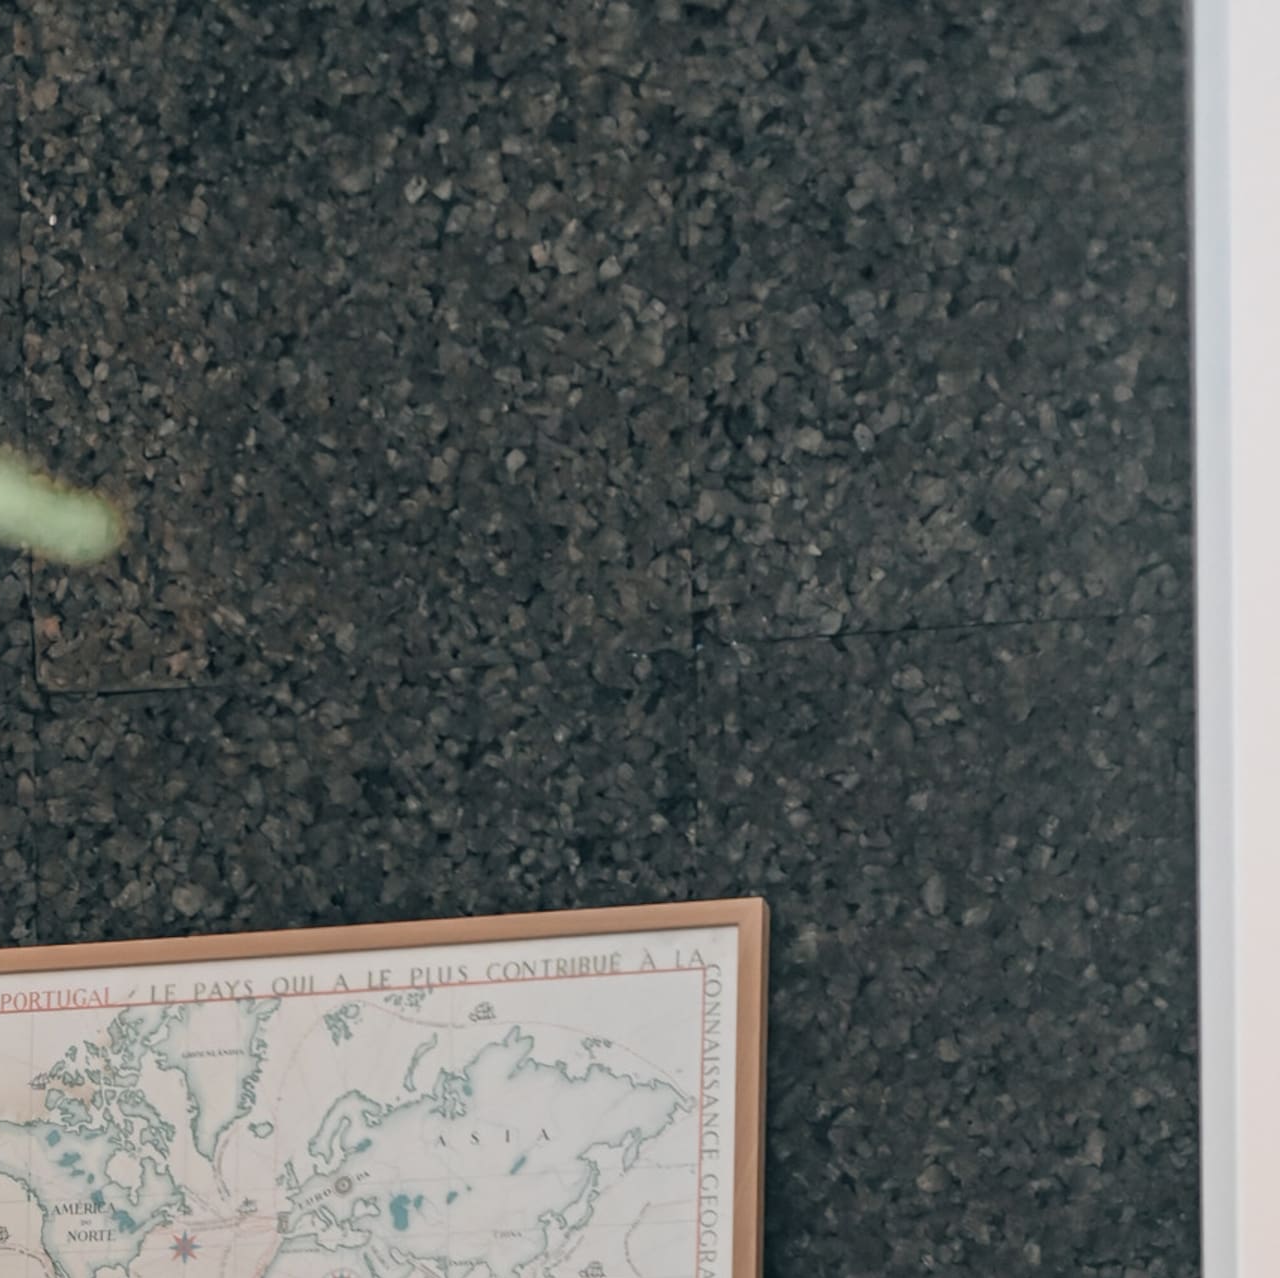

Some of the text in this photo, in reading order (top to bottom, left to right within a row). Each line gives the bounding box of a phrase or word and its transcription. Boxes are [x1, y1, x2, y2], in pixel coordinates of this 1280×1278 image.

[0, 987, 113, 1011] PORTUGAL
[150, 984, 176, 1004] LE
[194, 979, 254, 1000] PAYS
[272, 976, 315, 996] QUI
[334, 973, 350, 992] A
[368, 970, 392, 990] LE
[410, 965, 468, 986] PLUS
[675, 948, 705, 969] LA
[701, 963, 722, 1160] CONNAISSANCE
[67, 1229, 116, 1243] NORTE
